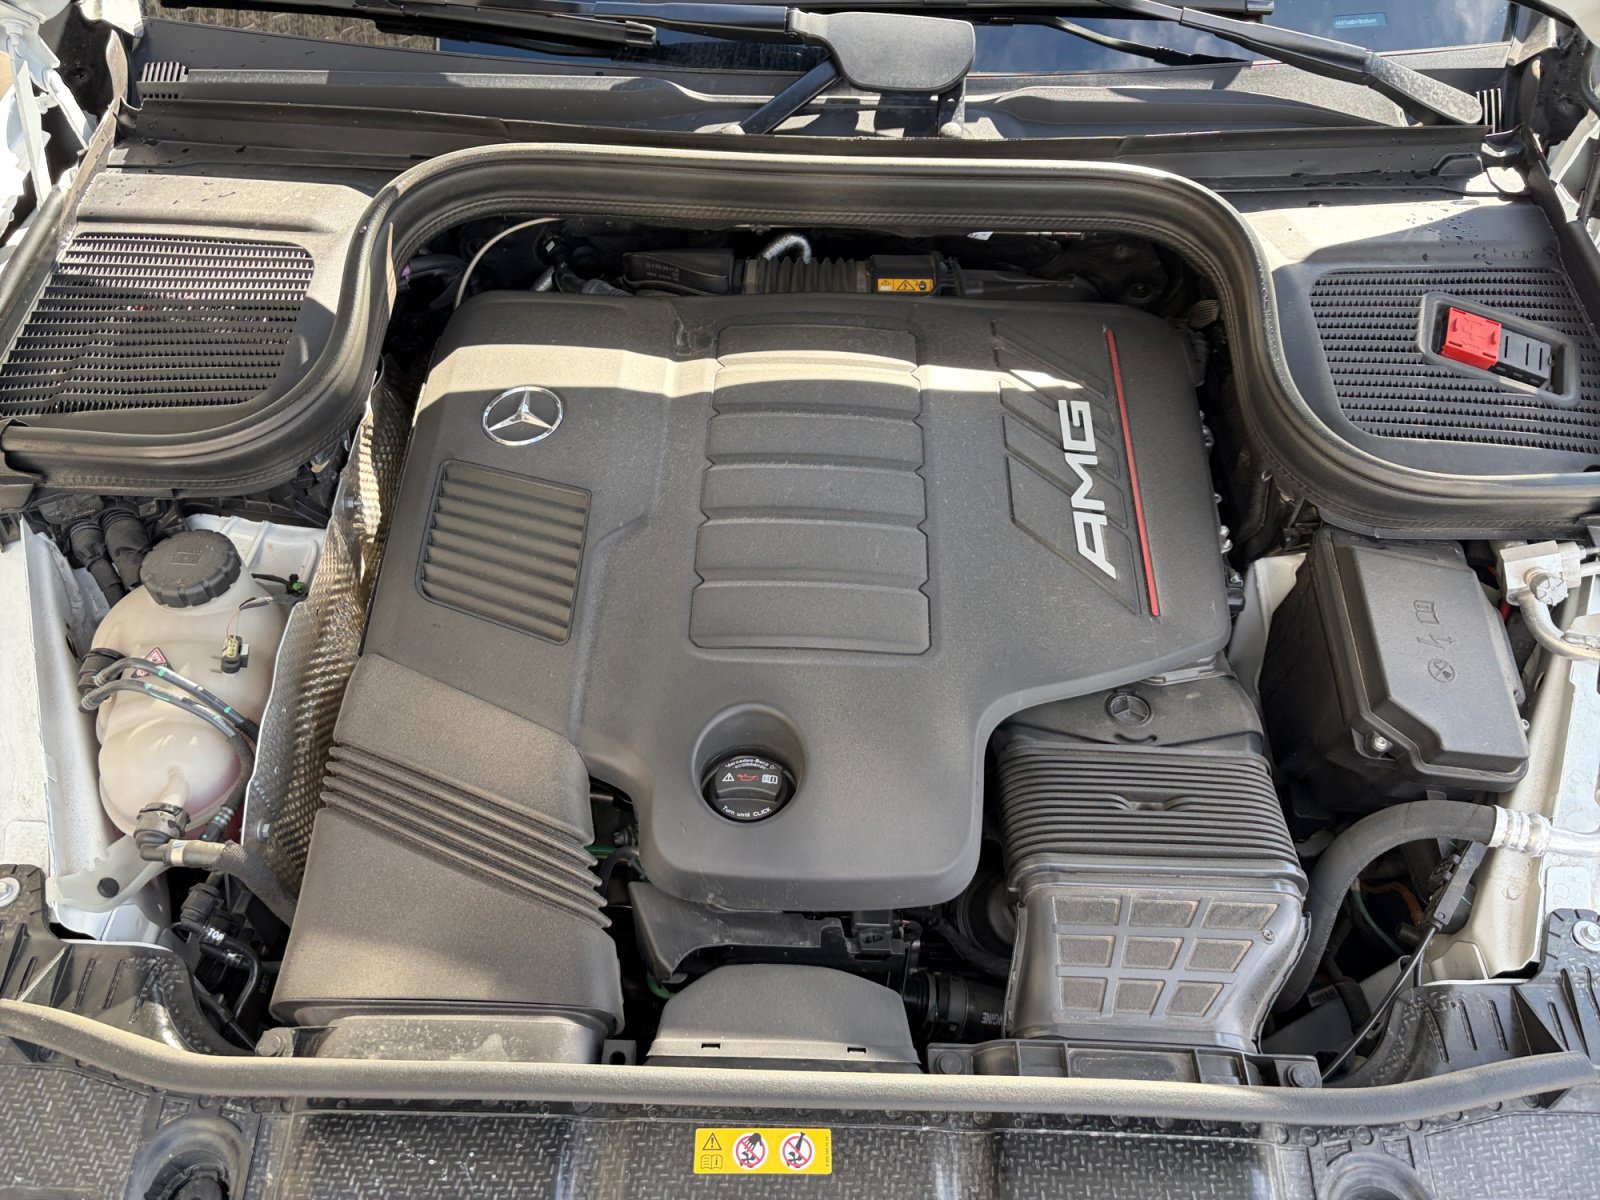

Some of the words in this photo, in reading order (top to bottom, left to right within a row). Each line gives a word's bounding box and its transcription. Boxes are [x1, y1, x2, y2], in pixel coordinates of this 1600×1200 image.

[1058, 400, 1116, 579] AMG
[722, 805, 735, 815] Turn
[752, 806, 772, 817] CLICK
[207, 927, 225, 941] TOP
[981, 1011, 1003, 1026] NGINE
